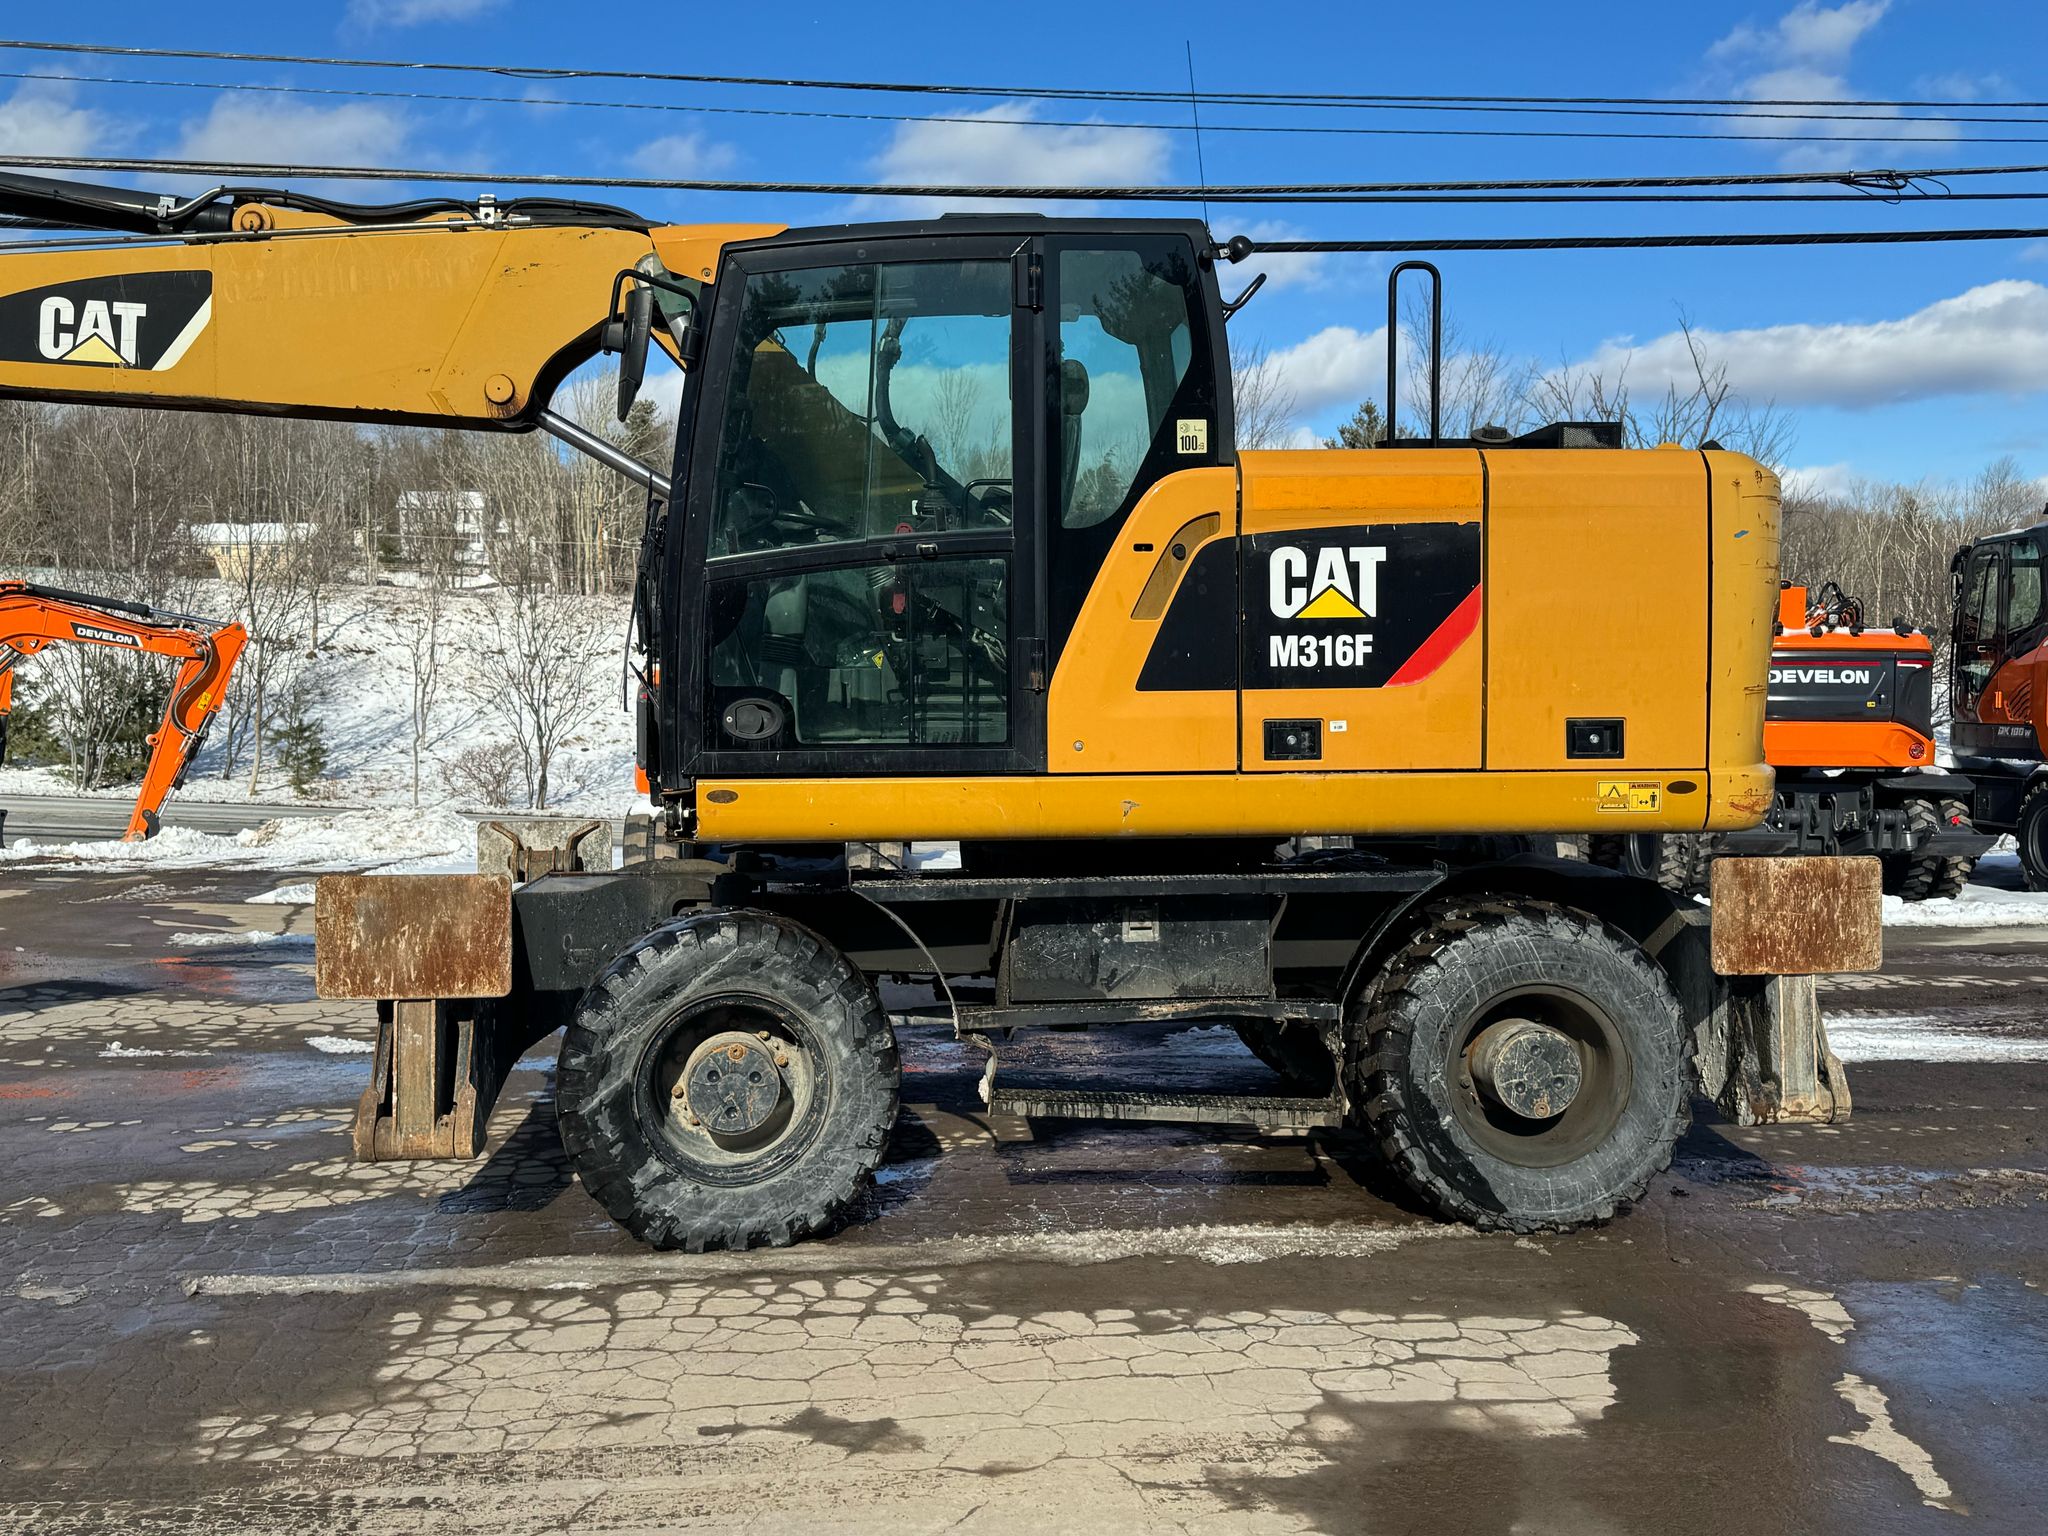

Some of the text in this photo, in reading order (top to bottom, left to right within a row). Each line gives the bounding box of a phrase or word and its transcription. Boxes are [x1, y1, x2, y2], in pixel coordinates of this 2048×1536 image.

[39, 296, 147, 365] CAT
[1180, 435, 1198, 451] 100
[1269, 546, 1387, 619] CAT
[76, 627, 133, 645] DEVELON
[1269, 634, 1373, 667] M316F
[1768, 669, 1870, 684] DEVELON
